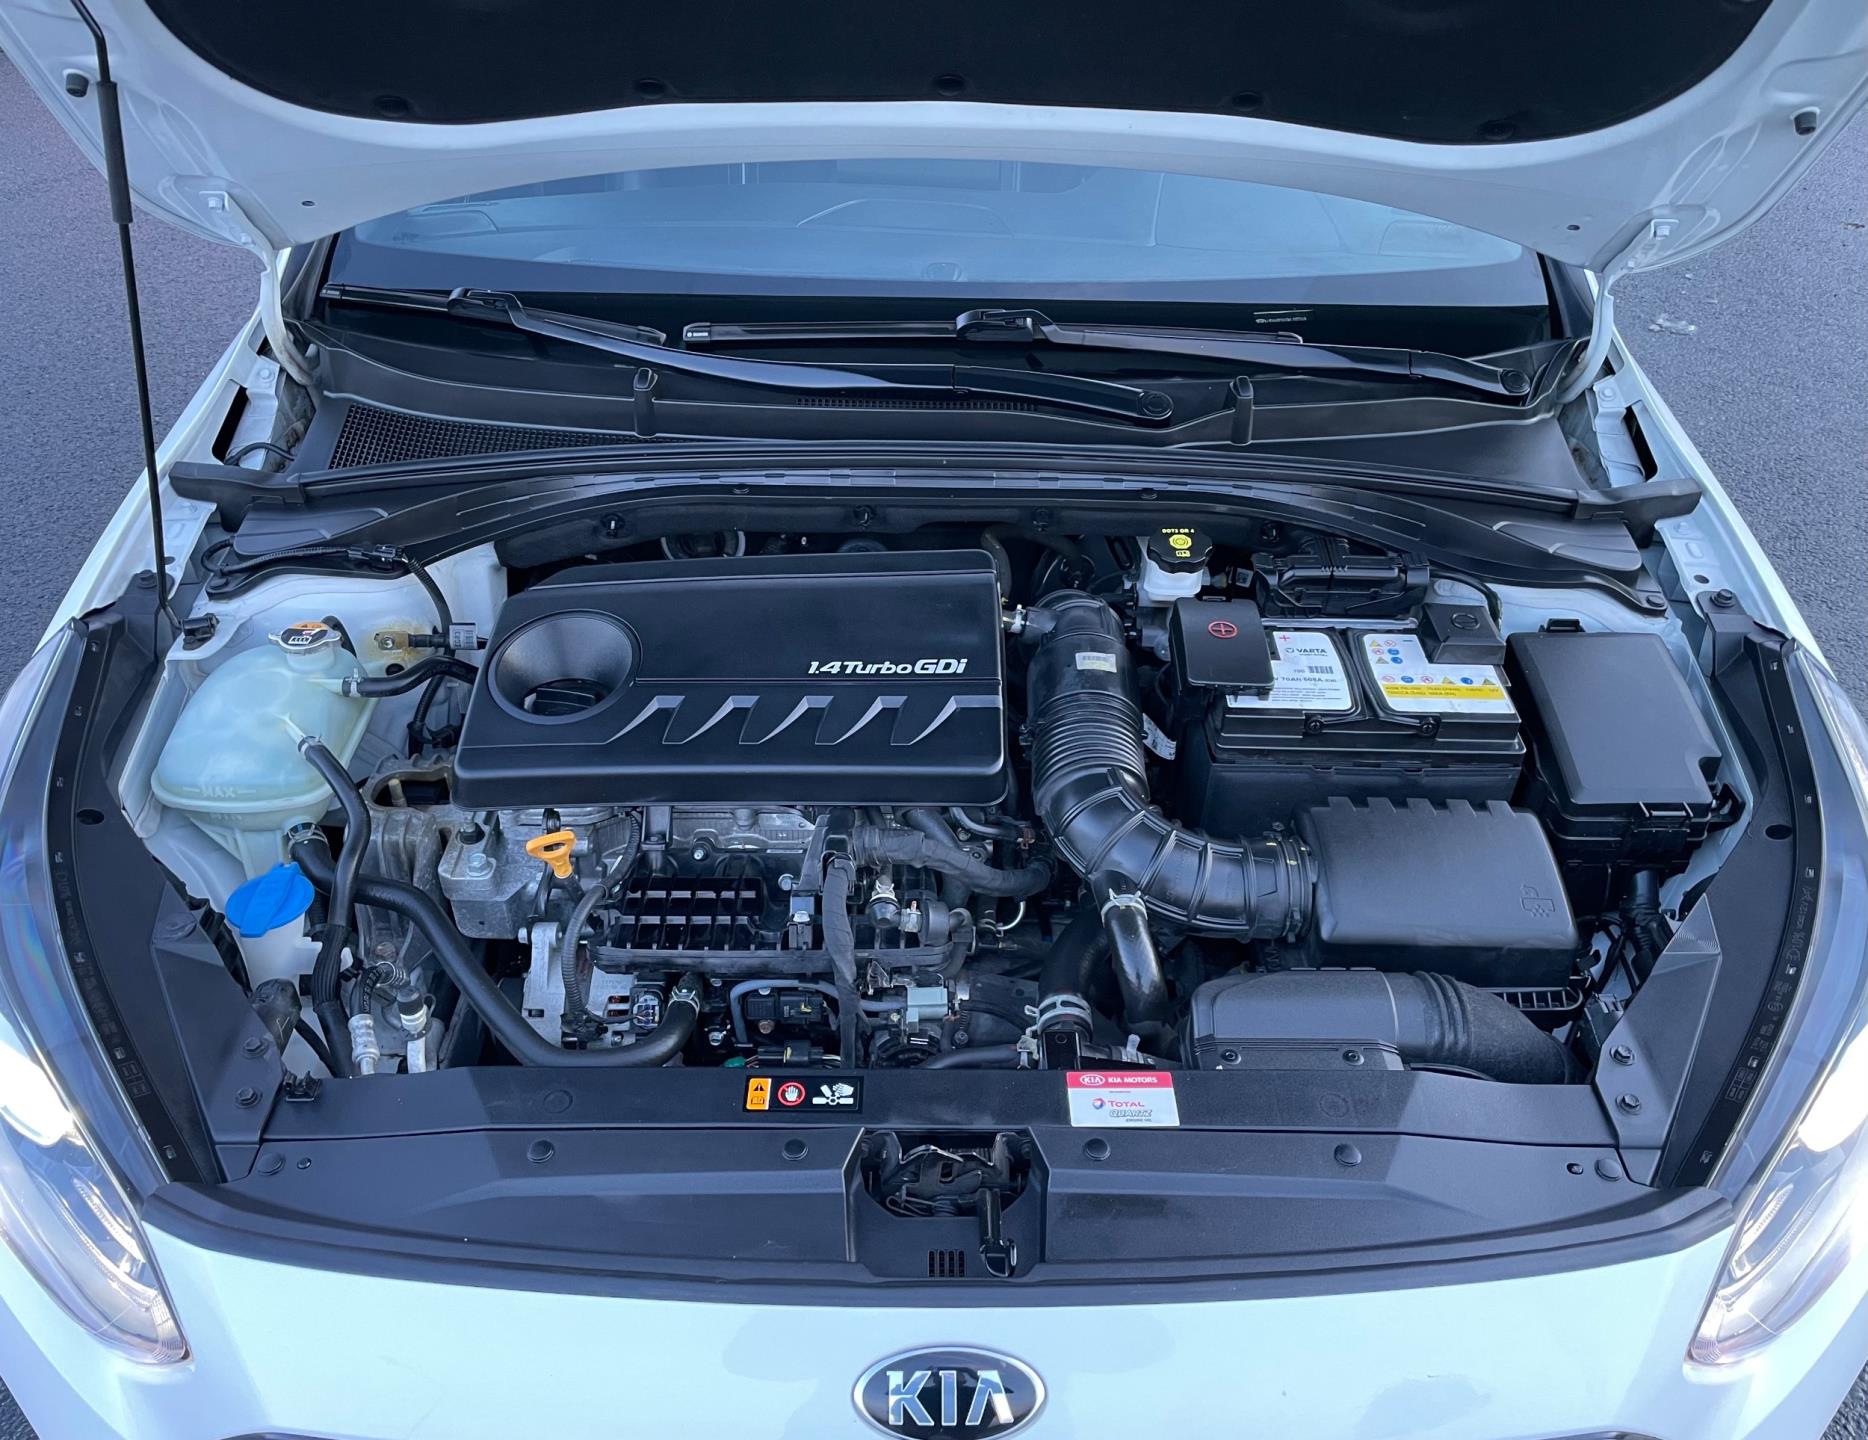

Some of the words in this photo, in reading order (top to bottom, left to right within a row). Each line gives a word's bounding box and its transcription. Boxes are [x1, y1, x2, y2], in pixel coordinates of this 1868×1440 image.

[808, 661, 842, 674] 1.4
[843, 661, 912, 674] Turbo
[914, 658, 968, 674] GDi
[201, 785, 236, 798] MAX
[1083, 1076, 1101, 1084] KIA
[1109, 1109, 1153, 1118] QUARTZ
[886, 1370, 1014, 1426] KIA
